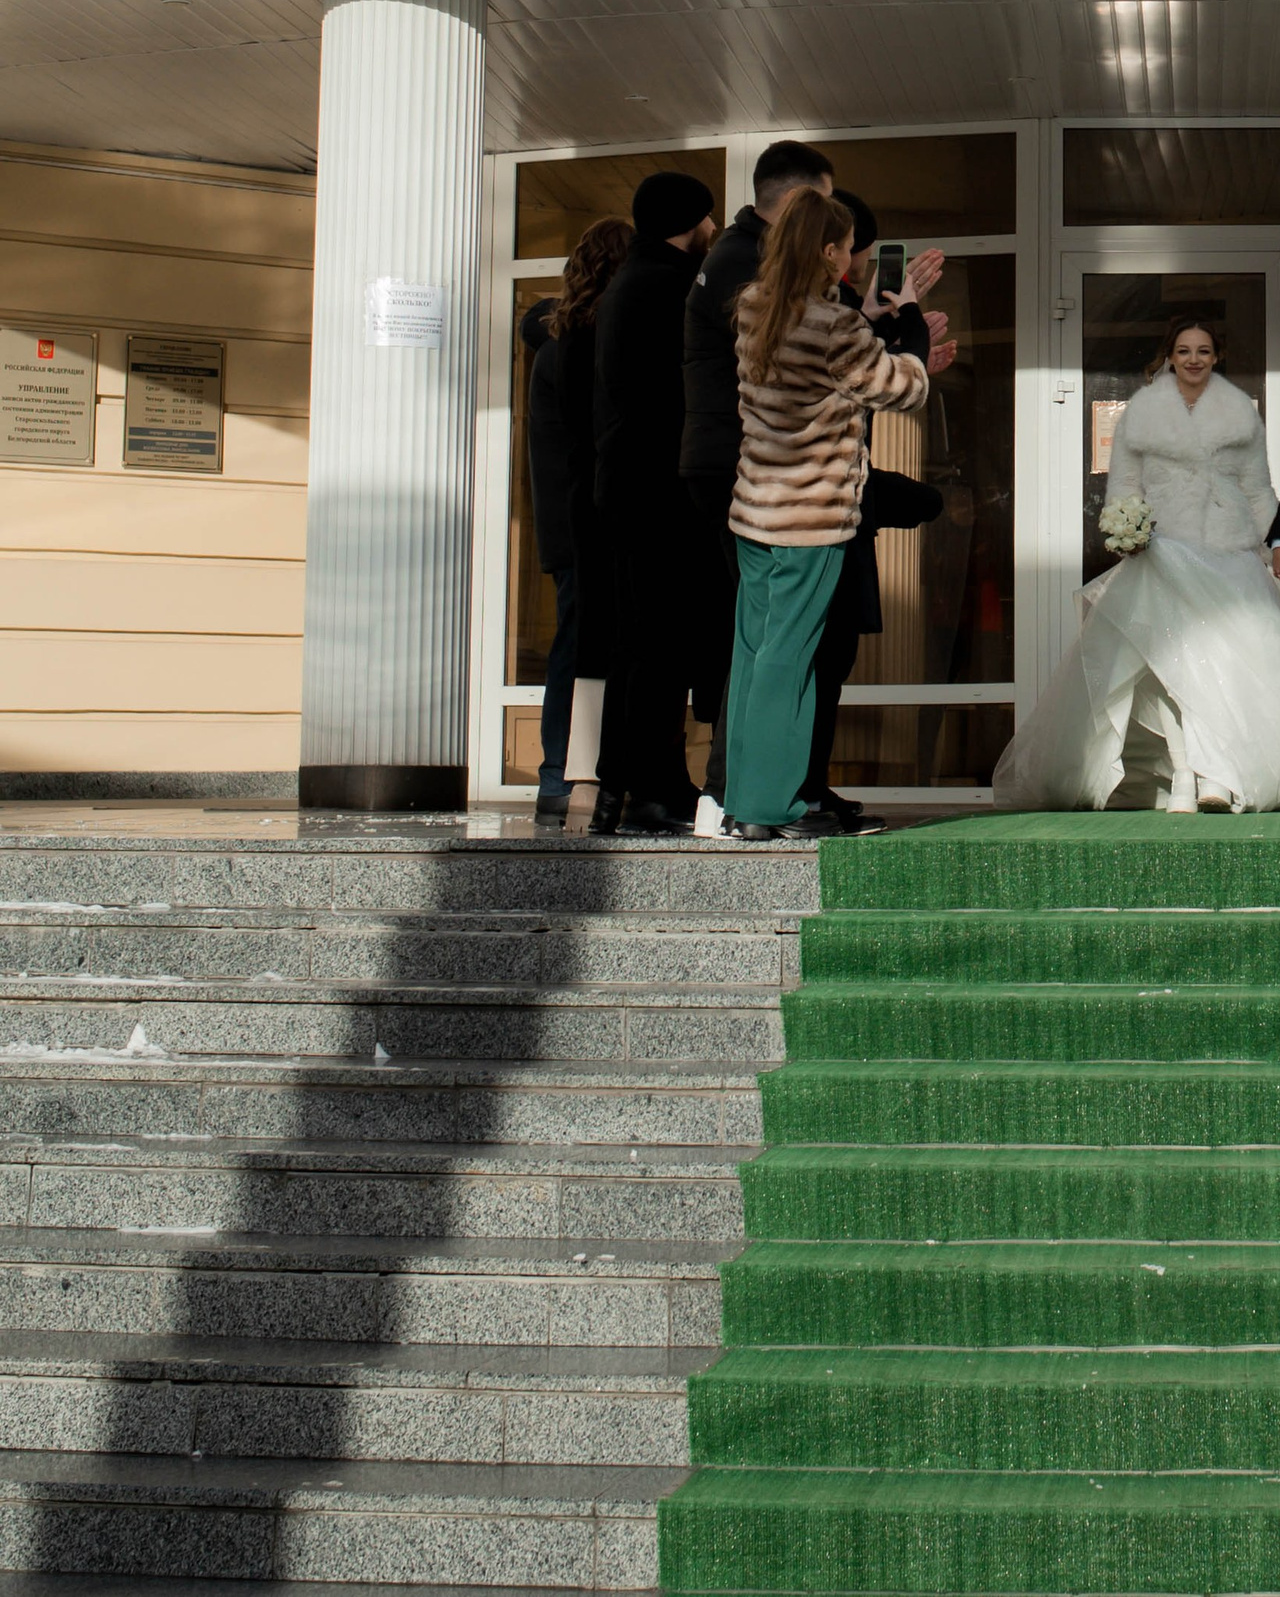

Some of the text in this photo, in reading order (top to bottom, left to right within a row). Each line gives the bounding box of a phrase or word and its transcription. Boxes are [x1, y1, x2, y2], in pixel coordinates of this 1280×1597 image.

[4, 363, 85, 376] РОССИЙСКАЯ ФЕДЕРАЦИЯ
[18, 384, 70, 394] УПРАВЛЕНИЕ
[42, 398, 85, 406] гражданского
[35, 408, 84, 416] администрации
[14, 426, 49, 434] городского
[7, 435, 76, 445] Белгородской области
